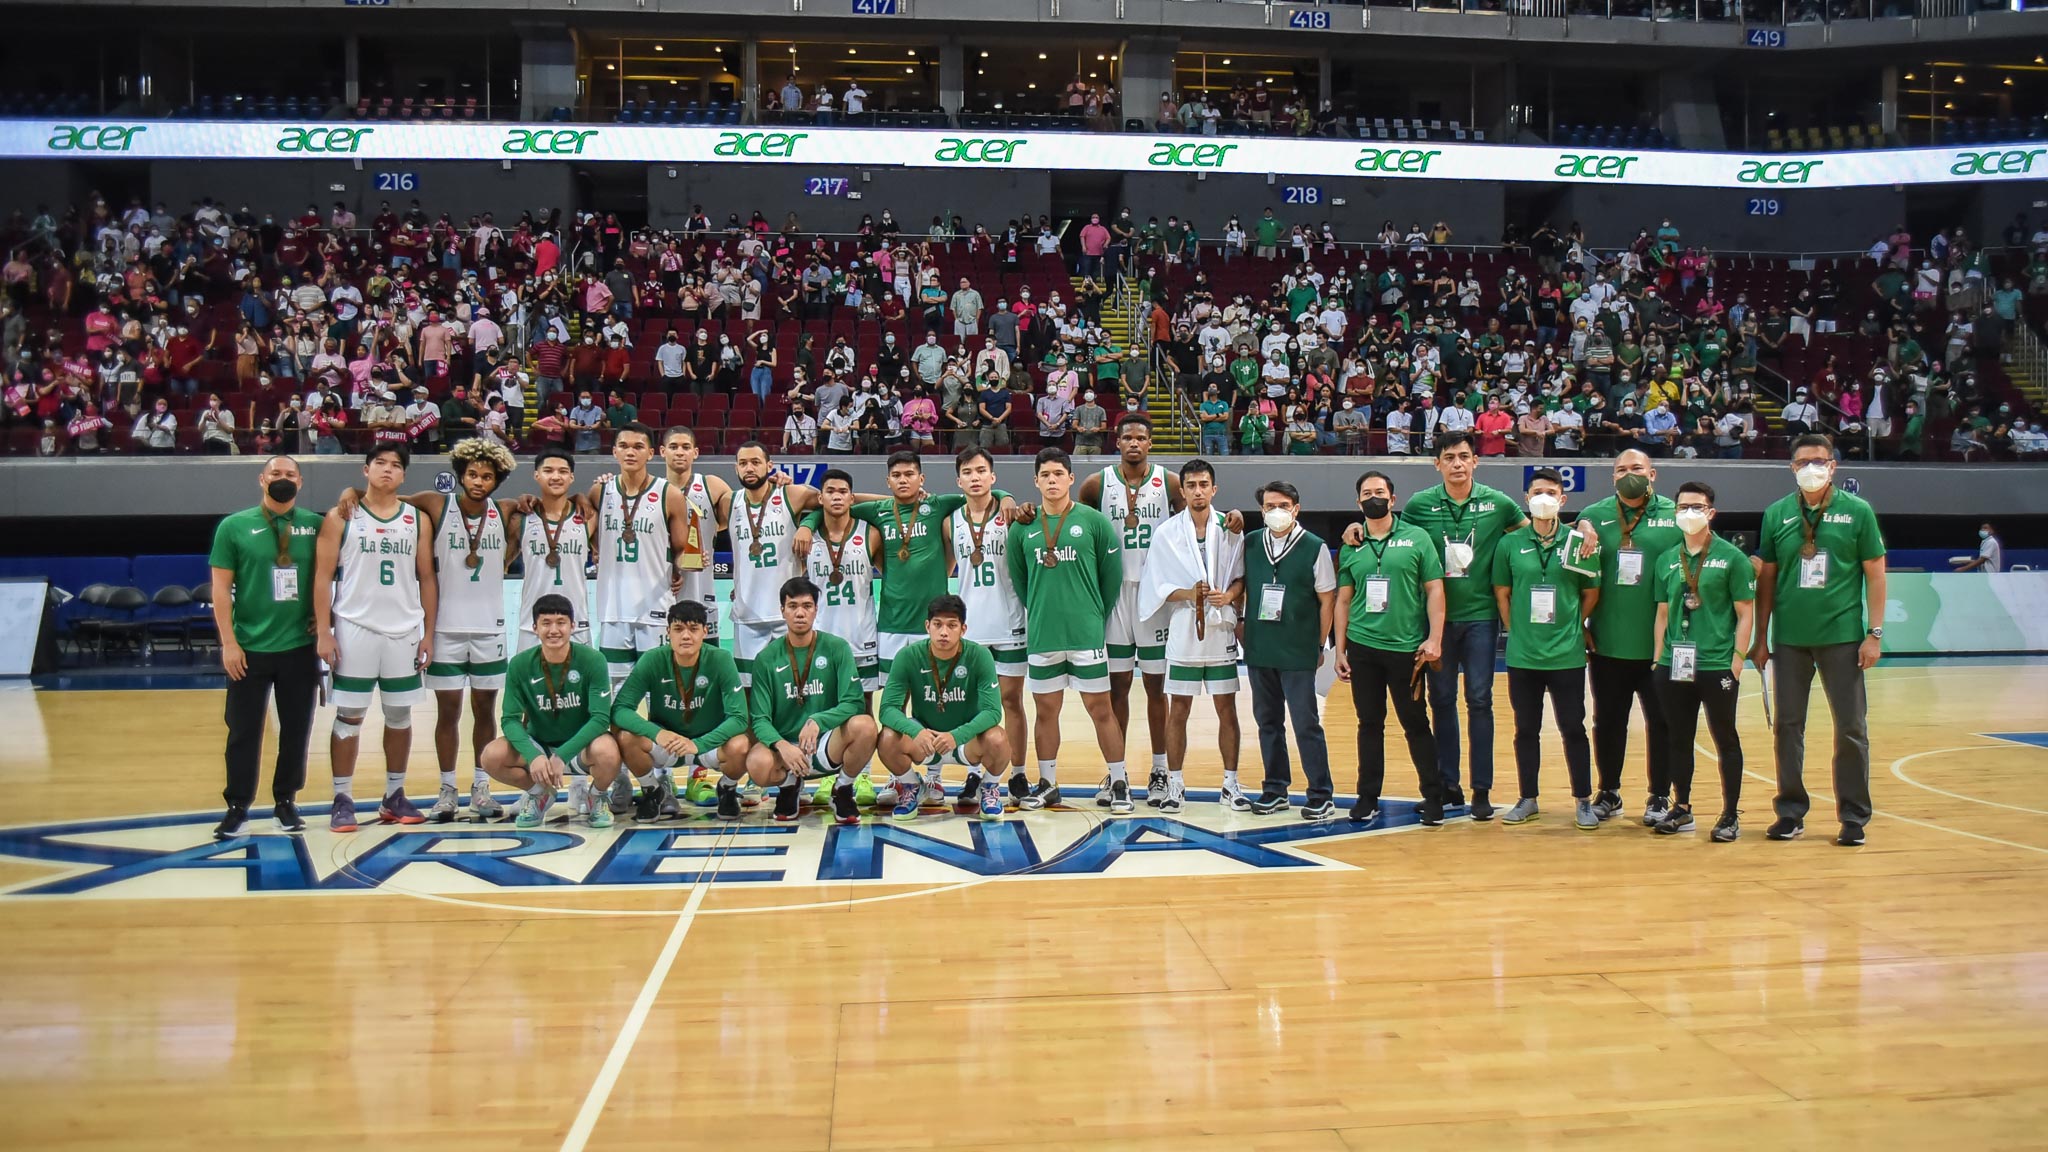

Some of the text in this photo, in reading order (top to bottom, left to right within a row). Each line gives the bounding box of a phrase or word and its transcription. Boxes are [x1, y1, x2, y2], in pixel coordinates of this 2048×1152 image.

[857, 0, 890, 13] 417
[1294, 12, 1325, 28] 418
[1752, 31, 1780, 46] 419
[50, 125, 149, 151] acer
[278, 128, 374, 153] acer
[503, 129, 598, 154] acer
[714, 132, 809, 158] acer
[935, 138, 1029, 163] acer
[1149, 142, 1238, 167] acer
[1356, 148, 1441, 173] acer
[1556, 154, 1640, 179] acer
[1950, 149, 2047, 176] acer
[1738, 160, 1823, 184] acer
[379, 173, 413, 191] 216
[811, 178, 842, 195] 217
[1286, 186, 1318, 203] 218
[1750, 199, 1780, 215] 219
[1110, 504, 1125, 520] La
[604, 514, 618, 531] La
[449, 533, 465, 550] La
[735, 525, 749, 540] La
[884, 525, 896, 541] La
[1124, 523, 1151, 550] 22
[359, 536, 412, 556] La Salle
[529, 540, 546, 556] La
[616, 537, 639, 563] 19
[749, 542, 777, 568] 42
[958, 543, 971, 559] La
[380, 560, 394, 585] 6
[471, 556, 484, 582] 7
[813, 561, 829, 577] La
[973, 561, 995, 587] 16
[826, 581, 855, 607] 24
[497, 643, 504, 657] 7
[784, 682, 798, 699] La
[924, 685, 936, 702] La
[536, 694, 552, 711] La
[663, 694, 676, 709] La
[8, 815, 1328, 896] ARENA
